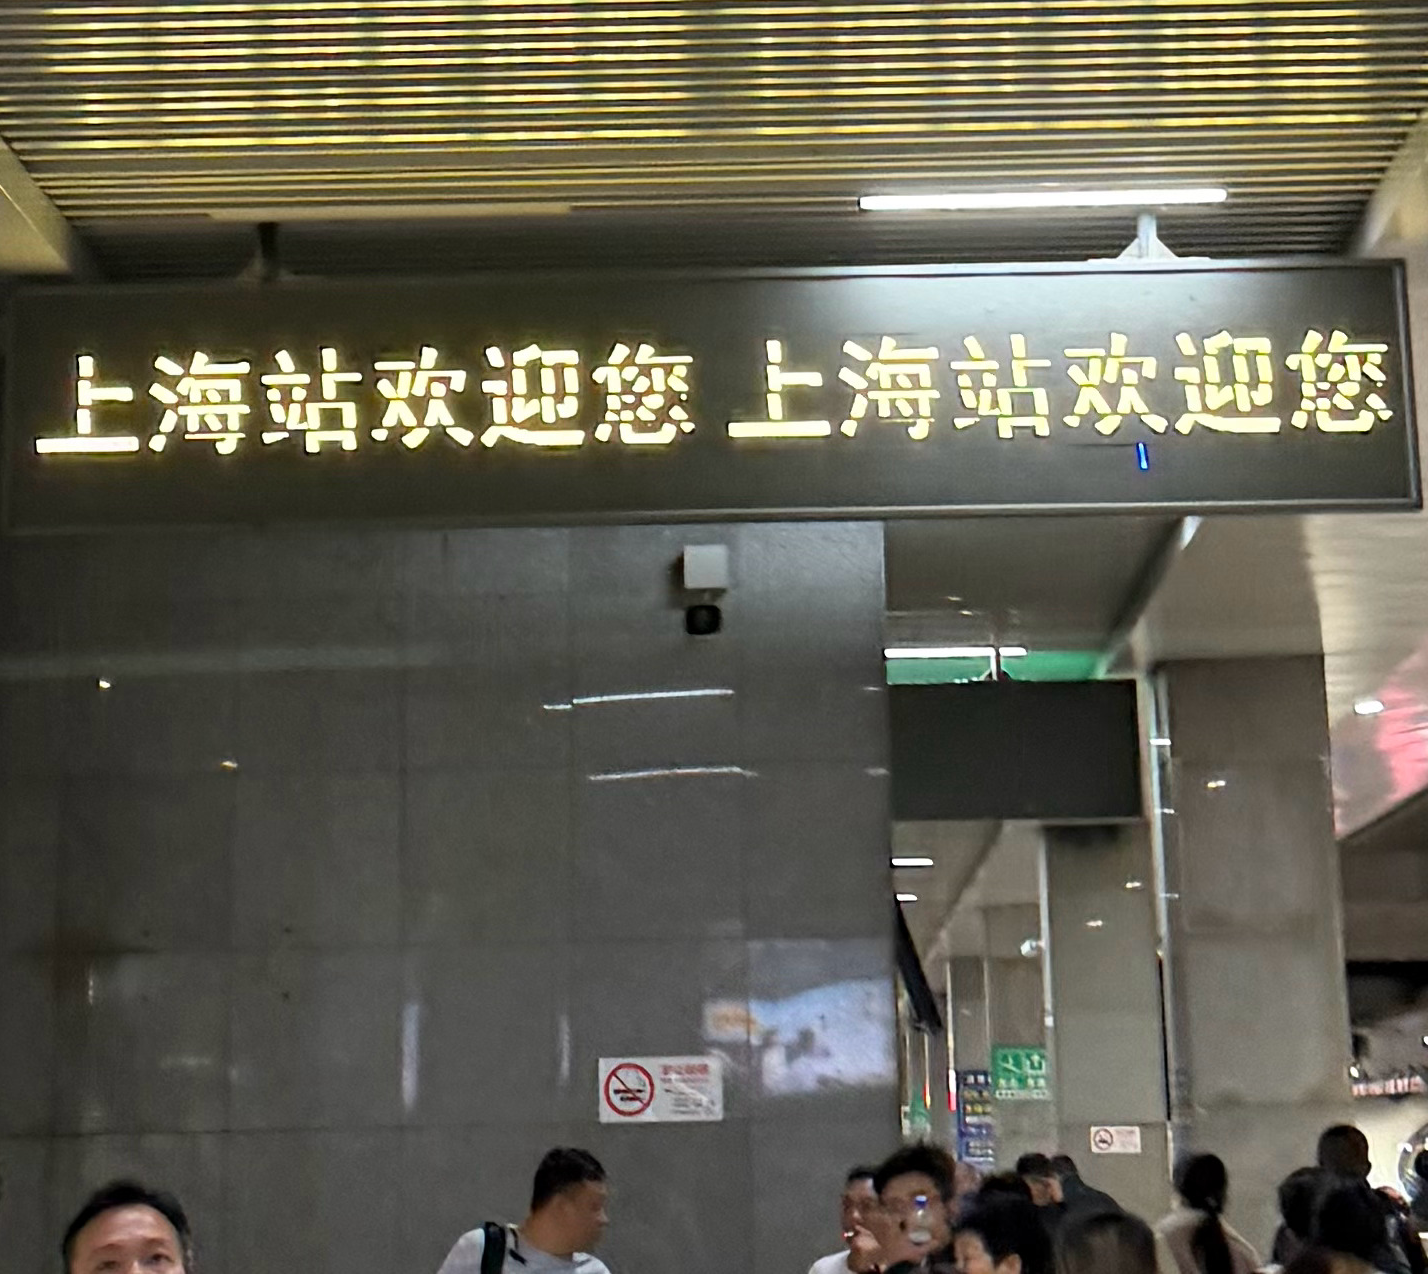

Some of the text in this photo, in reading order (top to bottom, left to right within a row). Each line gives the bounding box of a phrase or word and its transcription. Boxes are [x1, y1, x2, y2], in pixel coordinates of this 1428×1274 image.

[35, 331, 1394, 455] 上海站欢迎您 上海站欢迎您
